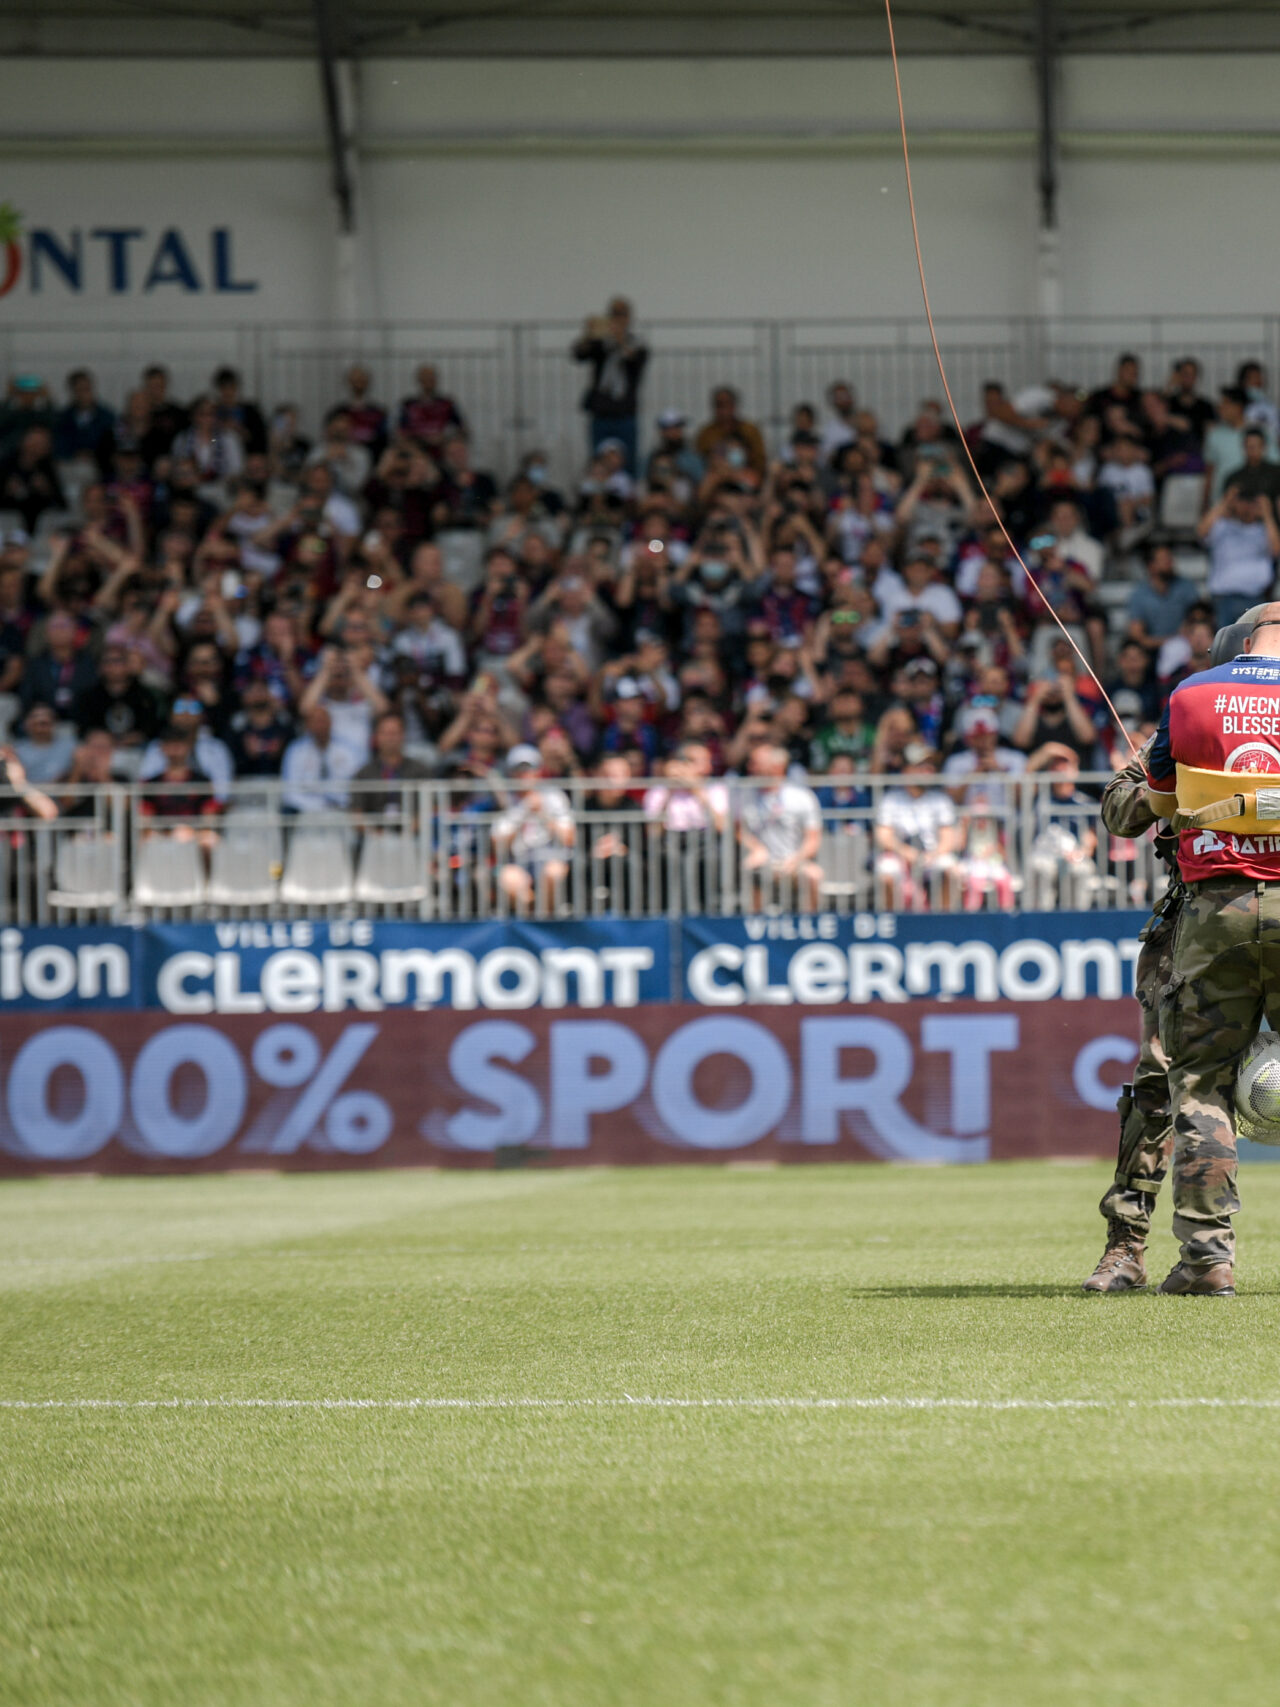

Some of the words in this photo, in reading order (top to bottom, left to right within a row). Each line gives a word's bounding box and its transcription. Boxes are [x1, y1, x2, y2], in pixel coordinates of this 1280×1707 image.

[0, 225, 260, 297] NTAL
[215, 921, 312, 949] VILLE
[329, 920, 374, 948] DE
[743, 915, 839, 941] VILLE
[854, 913, 897, 939] DE
[0, 927, 130, 1000] ion
[6, 1022, 395, 1161] 00%
[446, 1011, 1020, 1162] SPORT
